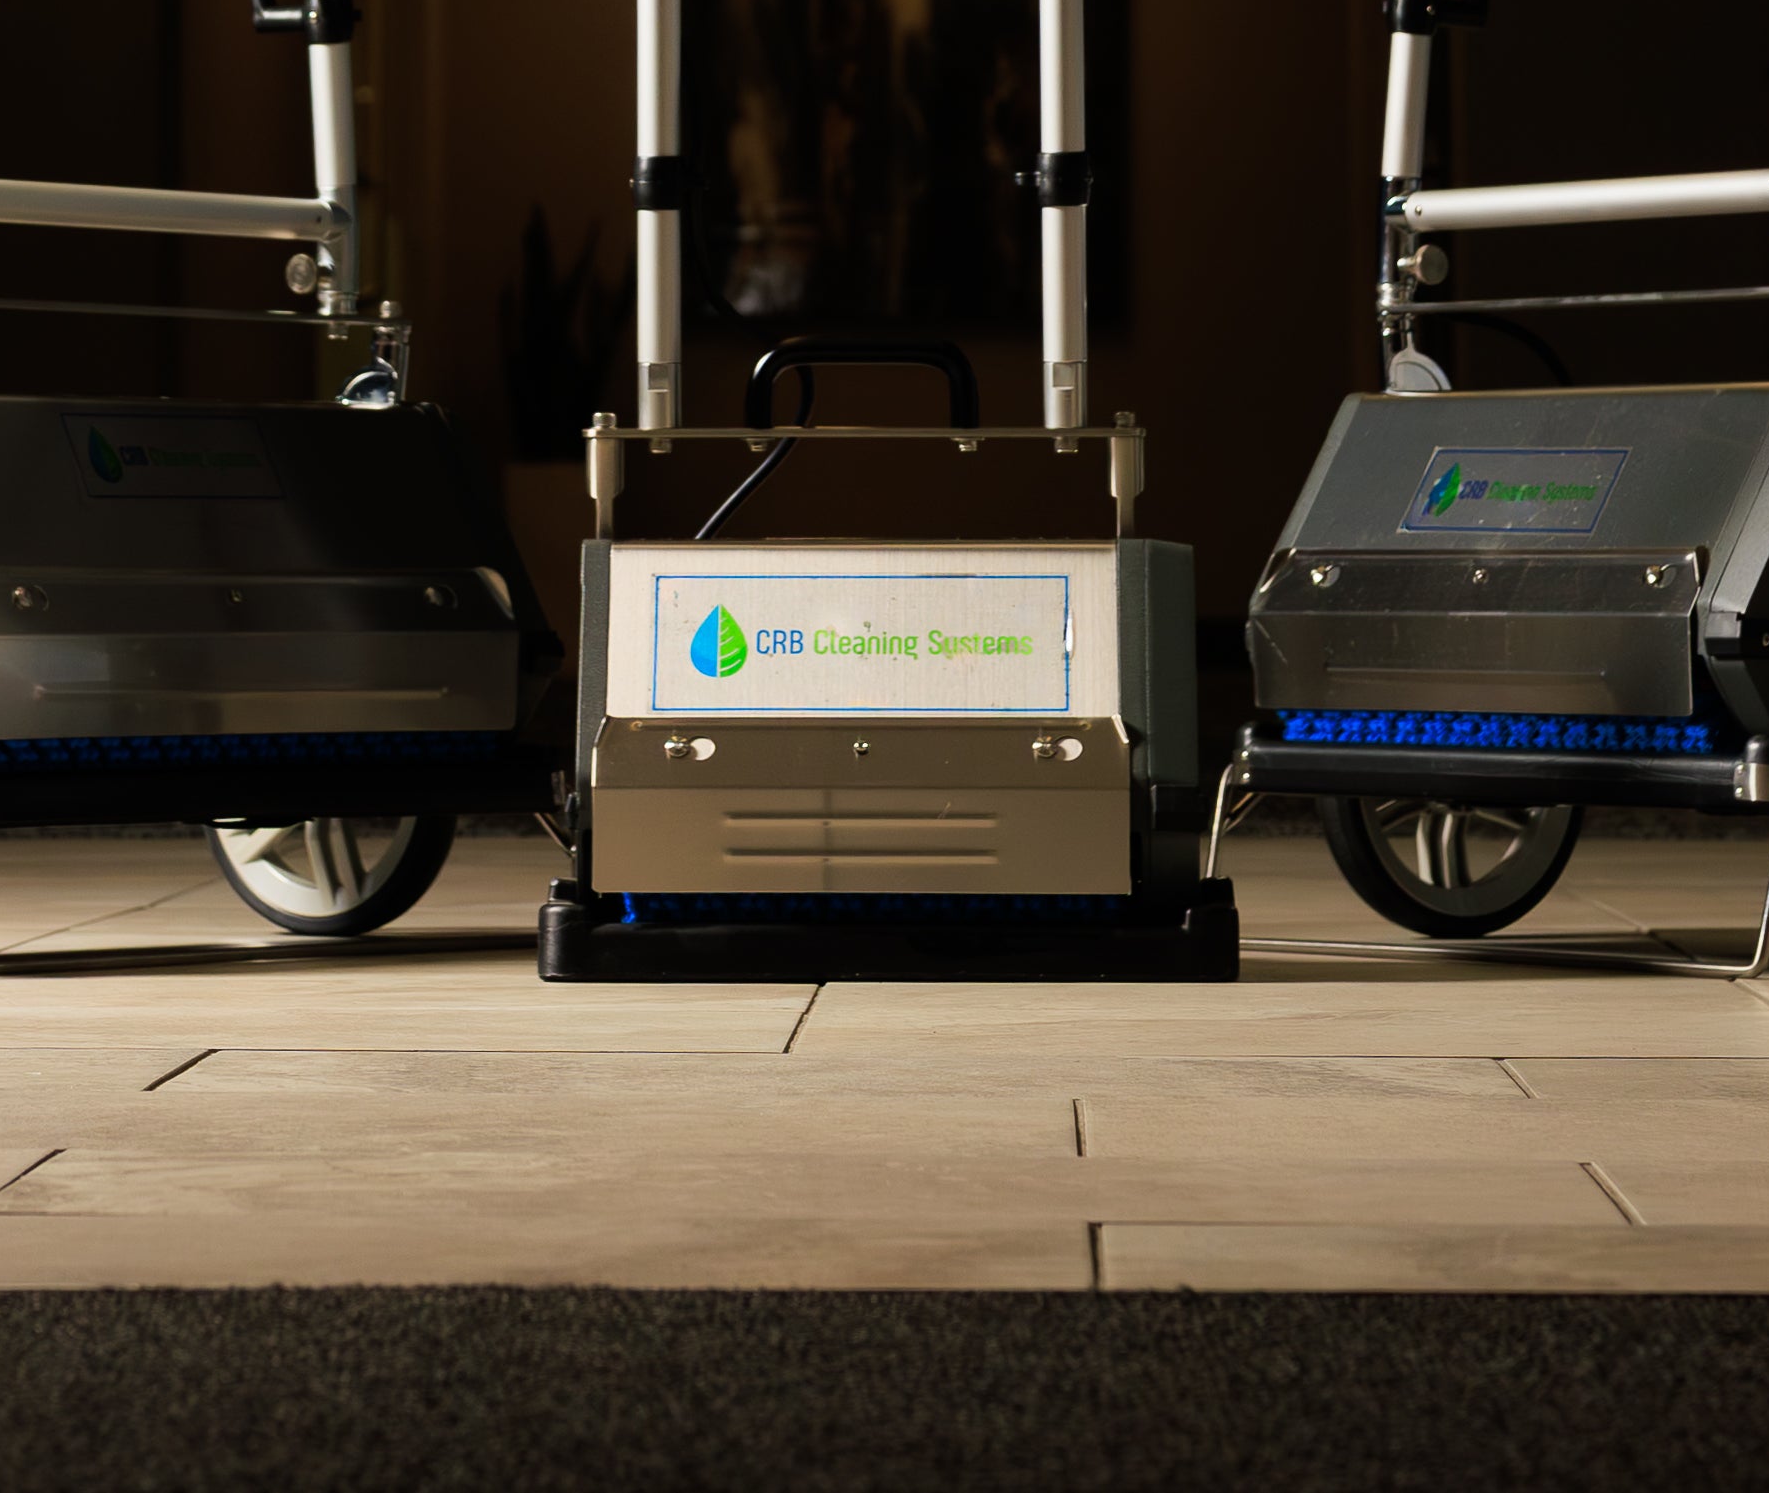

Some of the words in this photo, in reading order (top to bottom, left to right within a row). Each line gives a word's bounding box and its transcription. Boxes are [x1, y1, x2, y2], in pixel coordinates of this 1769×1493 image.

[755, 629, 804, 656] CRB
[813, 629, 919, 661] Cleaning
[927, 629, 1034, 657] Systems
